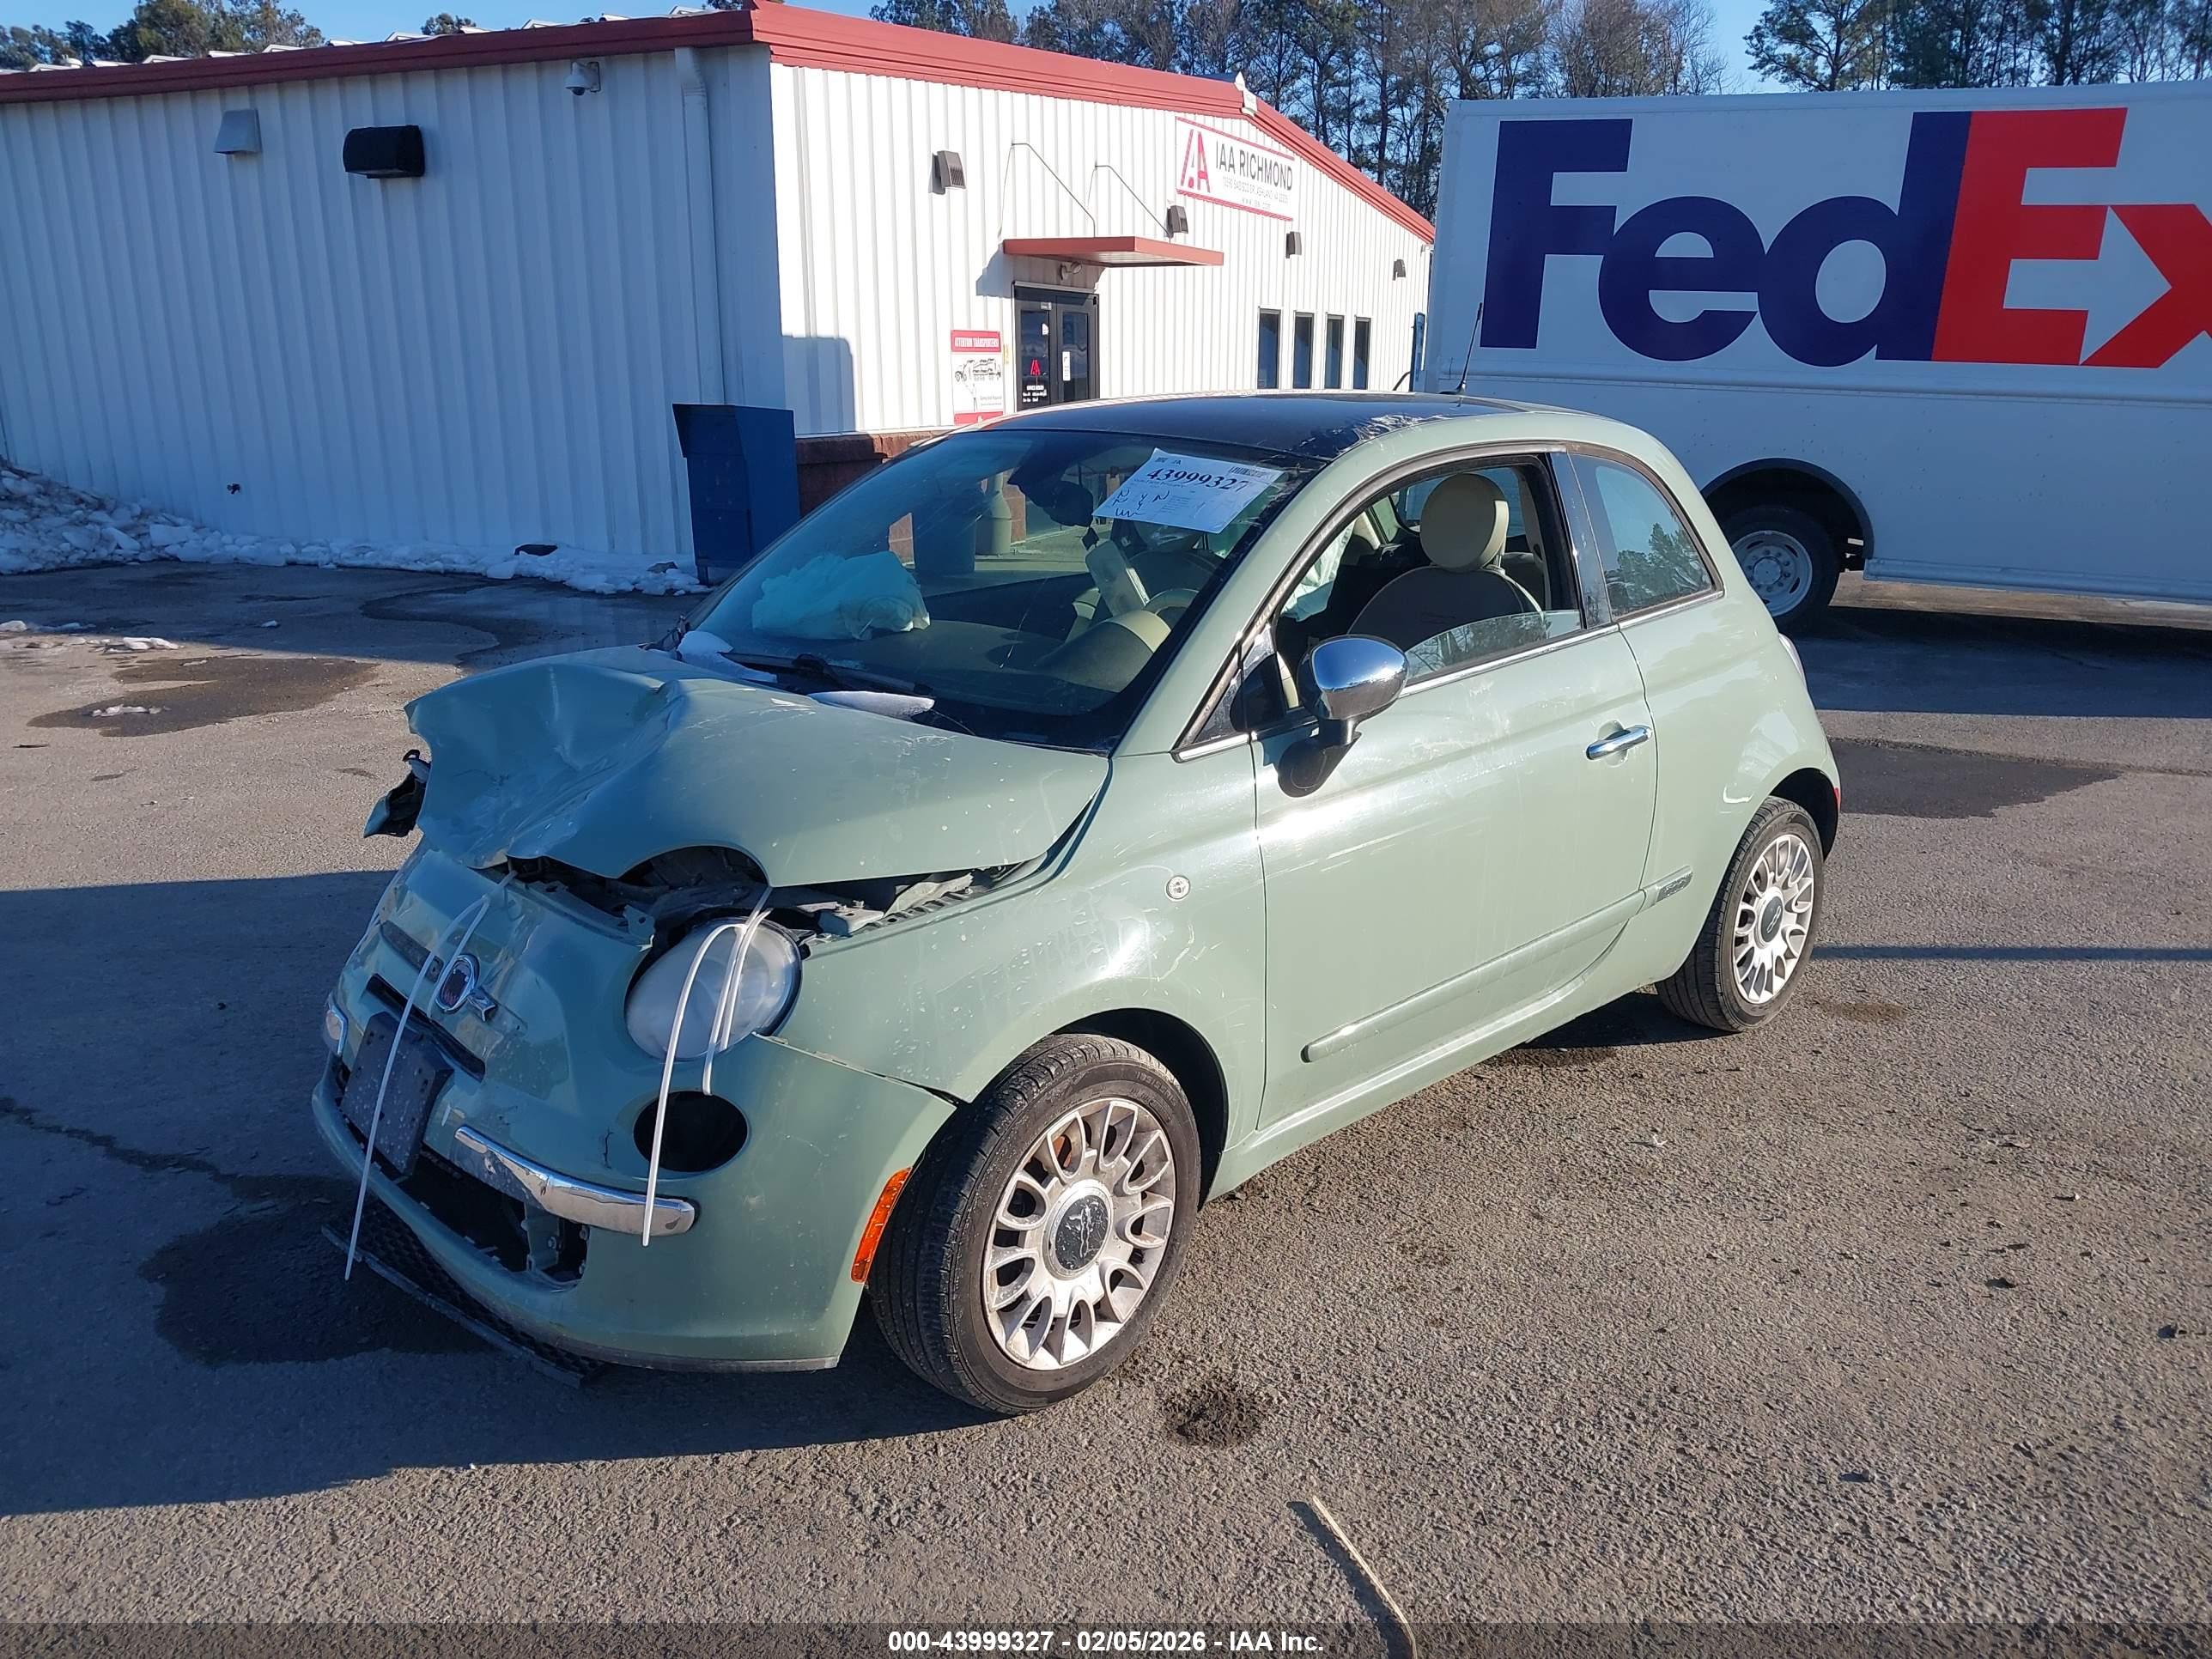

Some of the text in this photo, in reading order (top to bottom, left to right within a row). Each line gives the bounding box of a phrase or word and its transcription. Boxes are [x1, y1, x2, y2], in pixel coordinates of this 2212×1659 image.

[1216, 140, 1236, 174] IAA
[1239, 149, 1293, 191] RICHMOND
[1480, 107, 2212, 368] FedEx
[1146, 467, 1251, 493] 43999327
